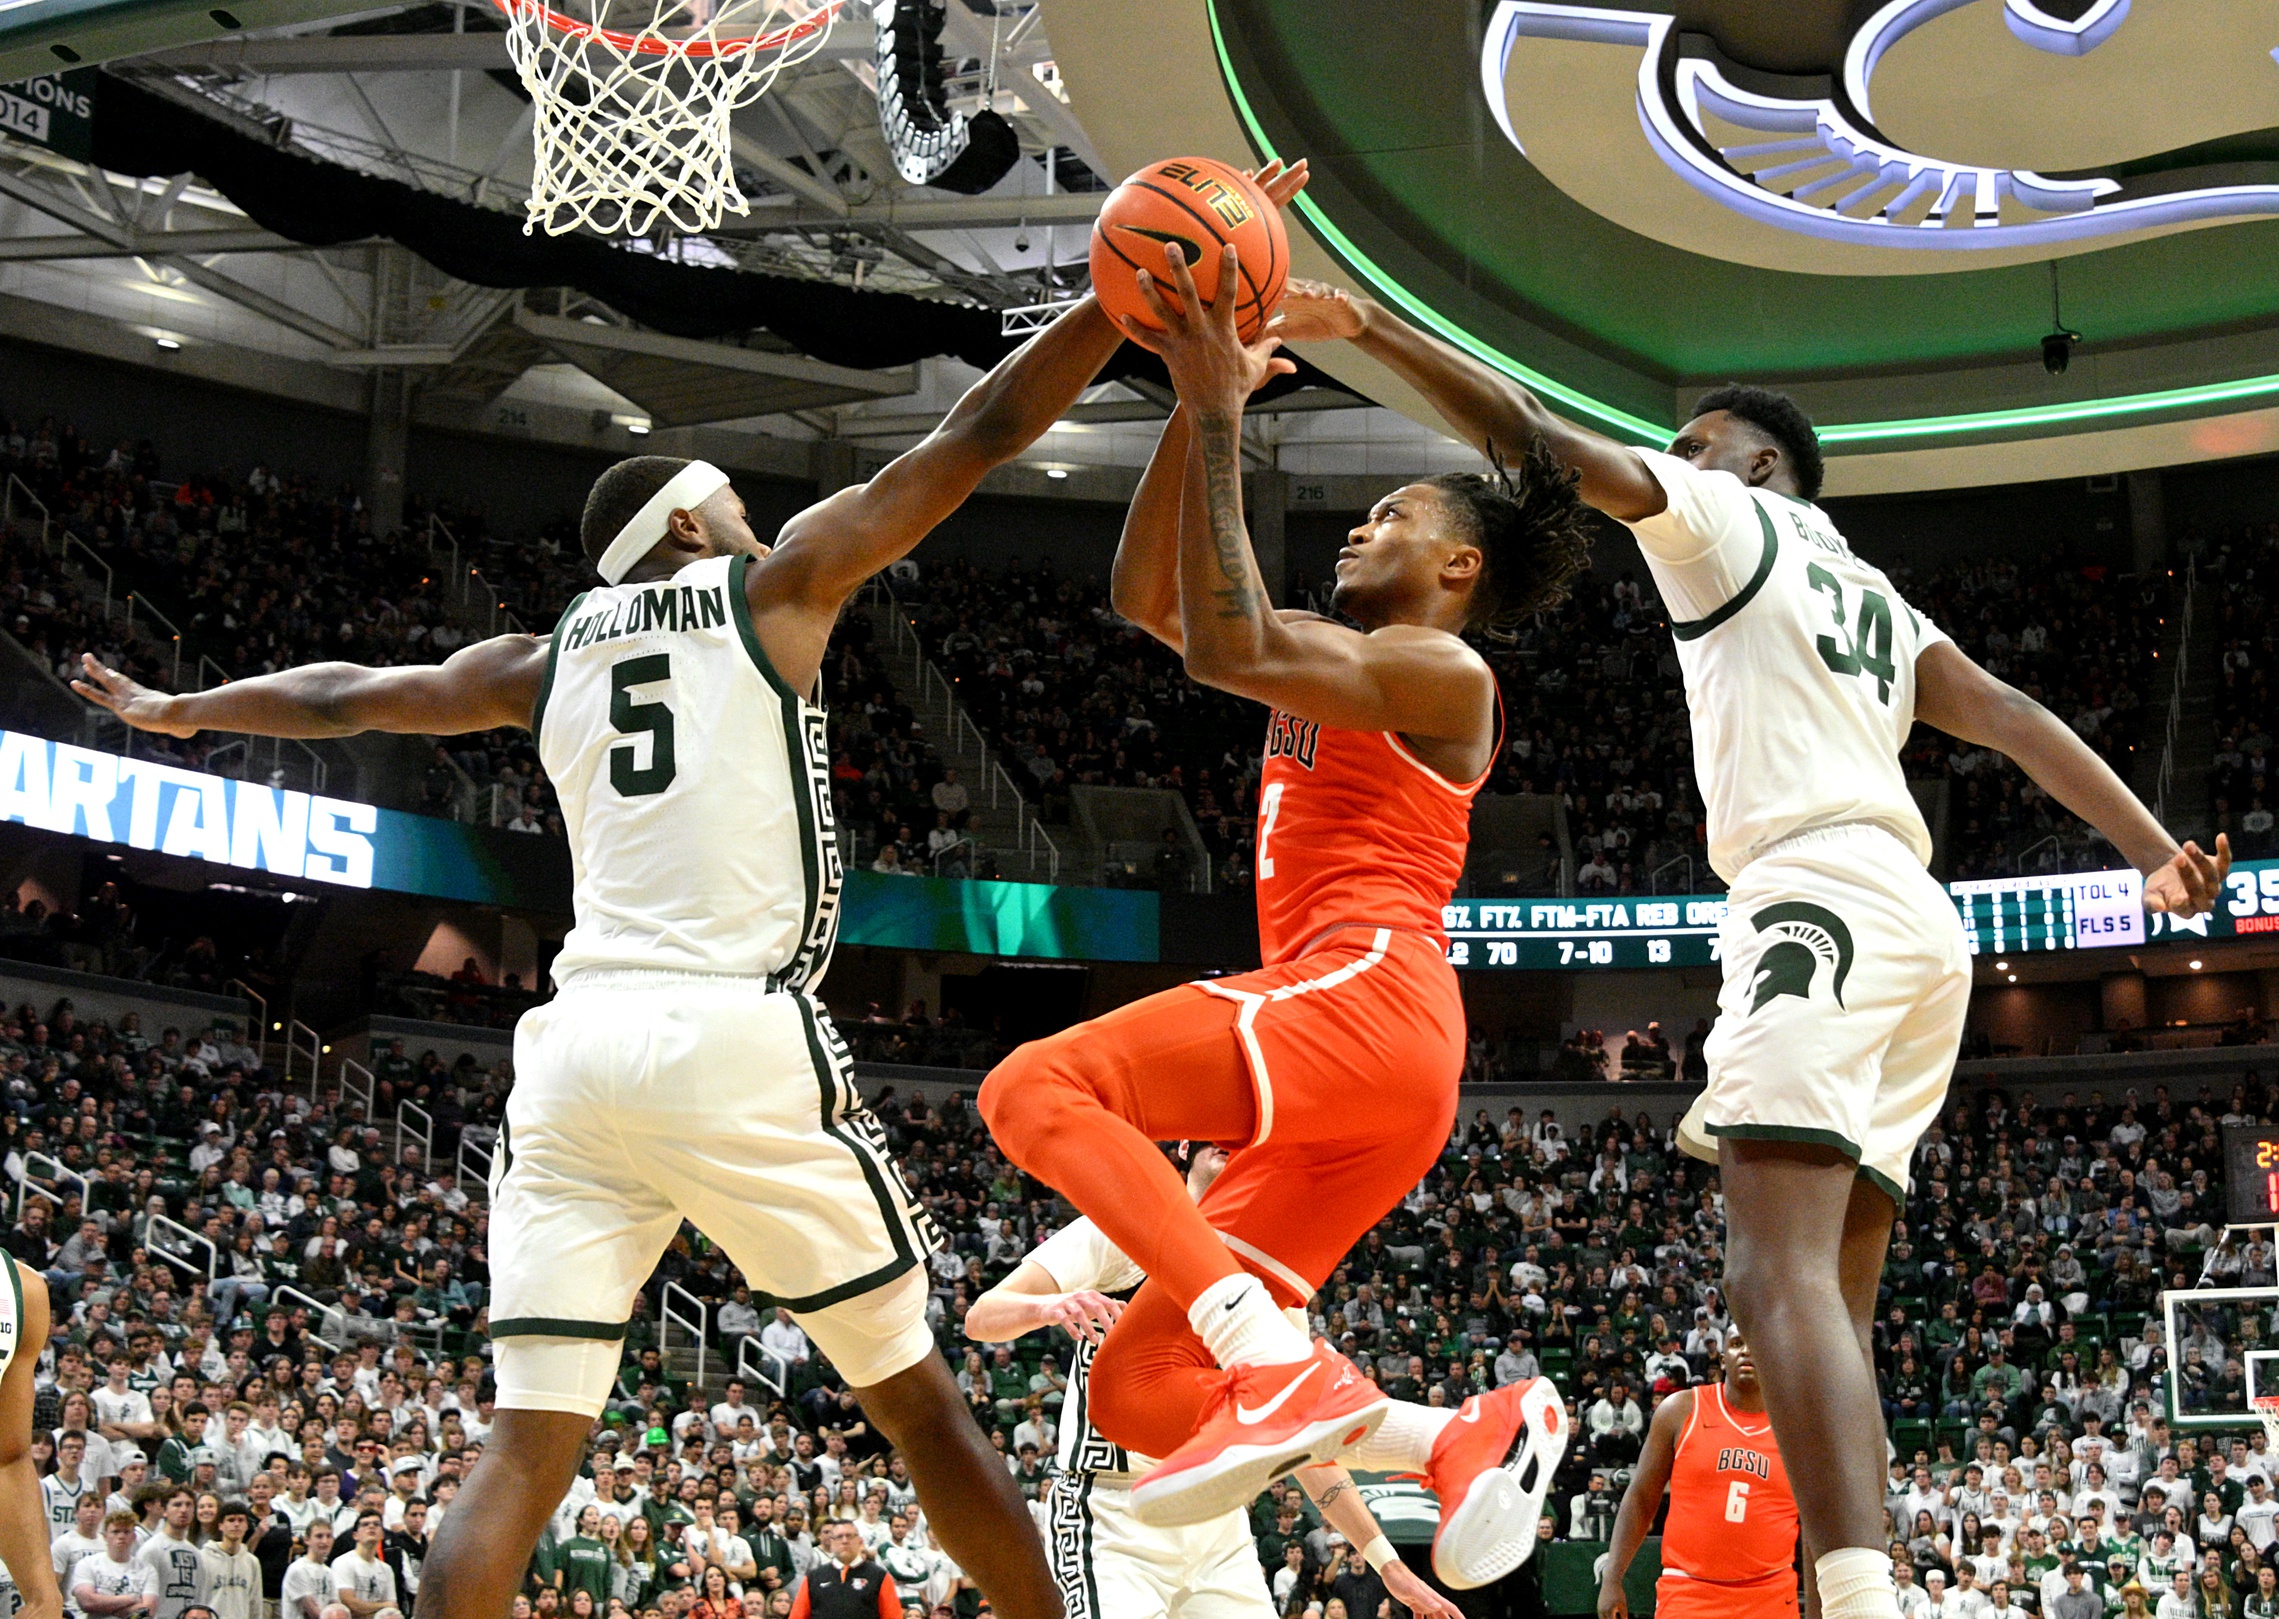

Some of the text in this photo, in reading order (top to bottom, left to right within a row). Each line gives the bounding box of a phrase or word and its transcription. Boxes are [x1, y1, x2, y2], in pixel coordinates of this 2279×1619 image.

[1157, 163, 1248, 231] ELITE
[1297, 486, 1324, 500] 216
[563, 586, 726, 652] HOLLOMAN
[1806, 561, 1896, 707] 34
[609, 653, 676, 798] 5
[1264, 710, 1320, 772] GSU
[0, 730, 377, 889] ARTANS
[1259, 783, 1284, 880] 2
[2079, 885, 2112, 900] TOL
[2118, 883, 2129, 897] 4
[1480, 905, 1522, 928] FT%
[1531, 904, 1629, 928] FTM-FTA
[1636, 903, 1678, 926] REB
[2080, 915, 2131, 934] FLS 5
[1487, 942, 1517, 965] 70
[1558, 941, 1612, 964] 7-10
[1647, 939, 1671, 962] 13
[2256, 1141, 2279, 1168] 2:
[1717, 1448, 1770, 1481] BGSU
[1725, 1480, 1750, 1524] 6
